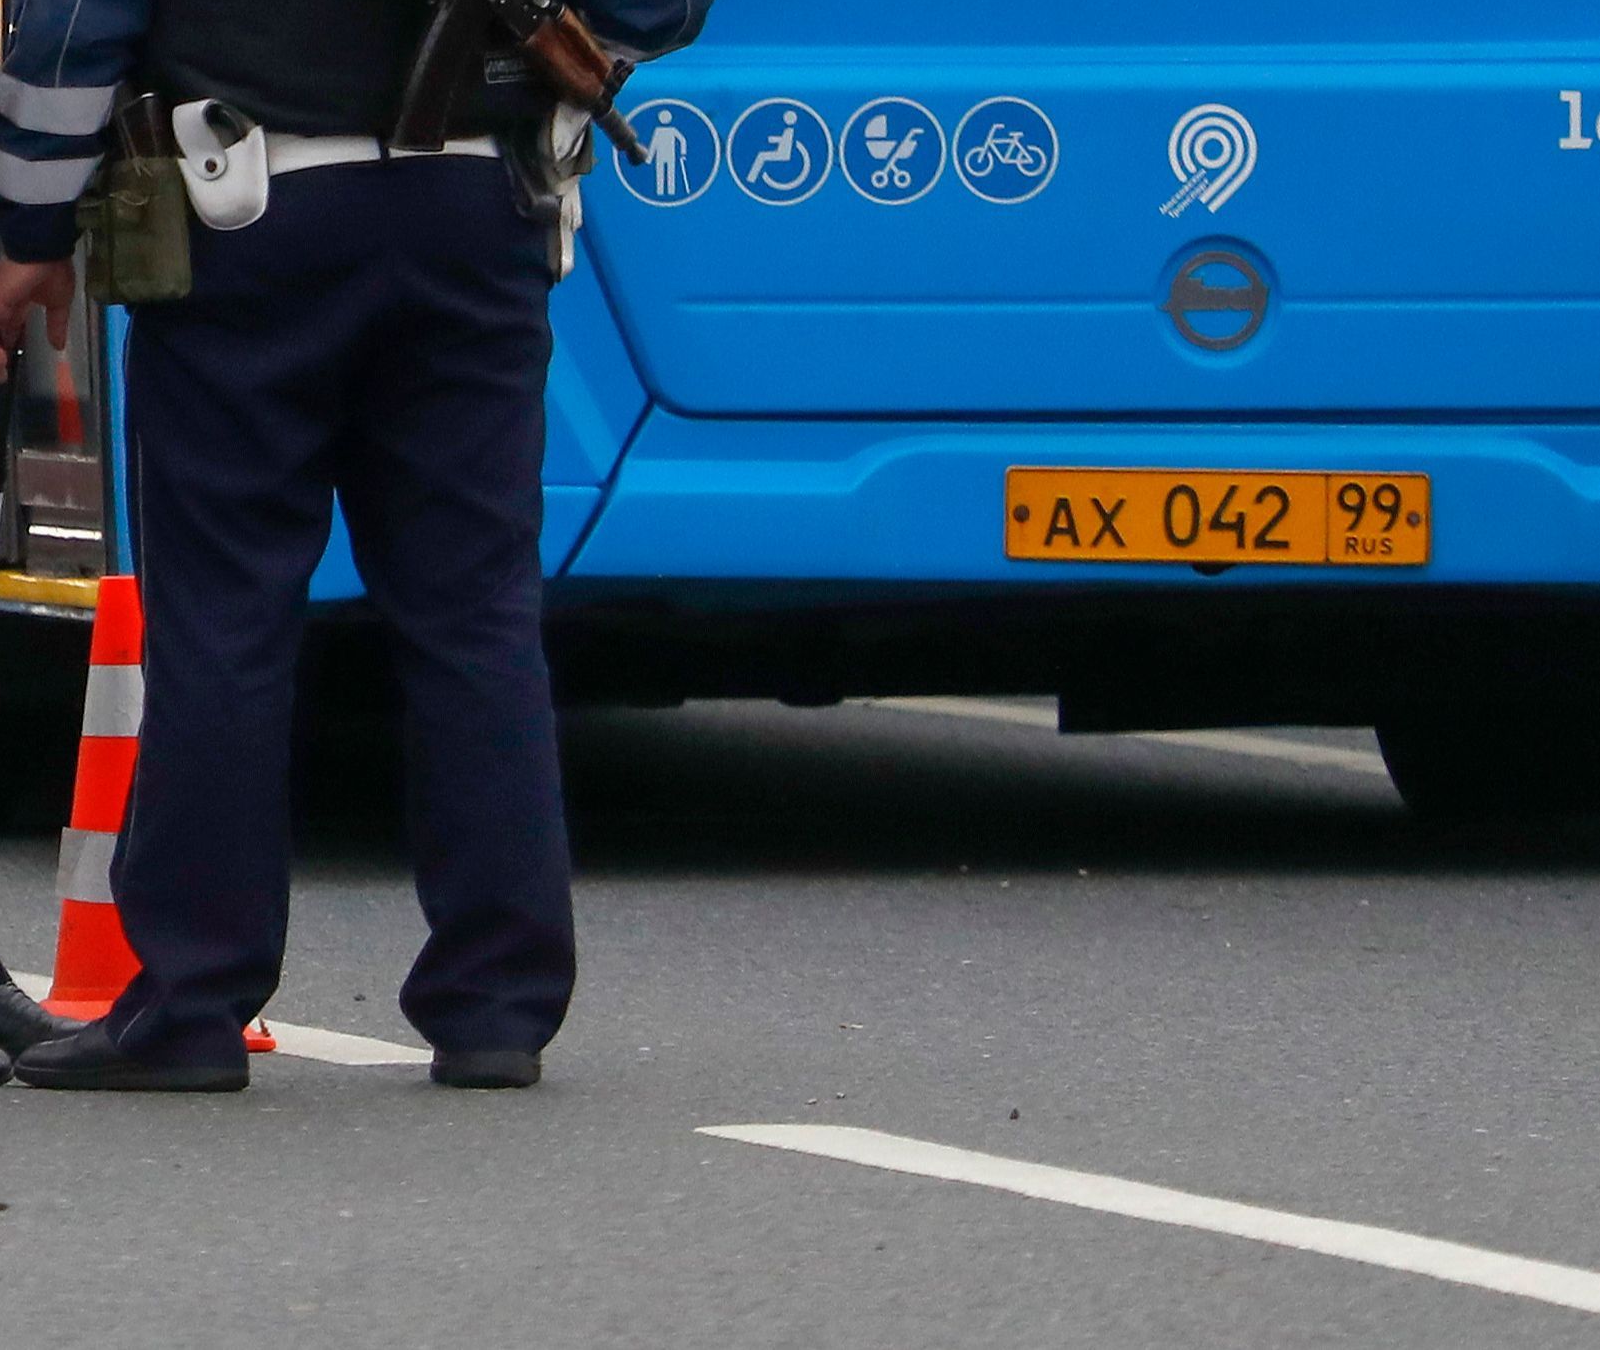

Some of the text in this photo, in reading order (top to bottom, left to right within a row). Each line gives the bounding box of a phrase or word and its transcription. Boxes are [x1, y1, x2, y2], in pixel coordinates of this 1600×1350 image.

[1163, 483, 1291, 550] 042
[1337, 481, 1402, 533] 99
[1344, 536, 1394, 556] RUS
